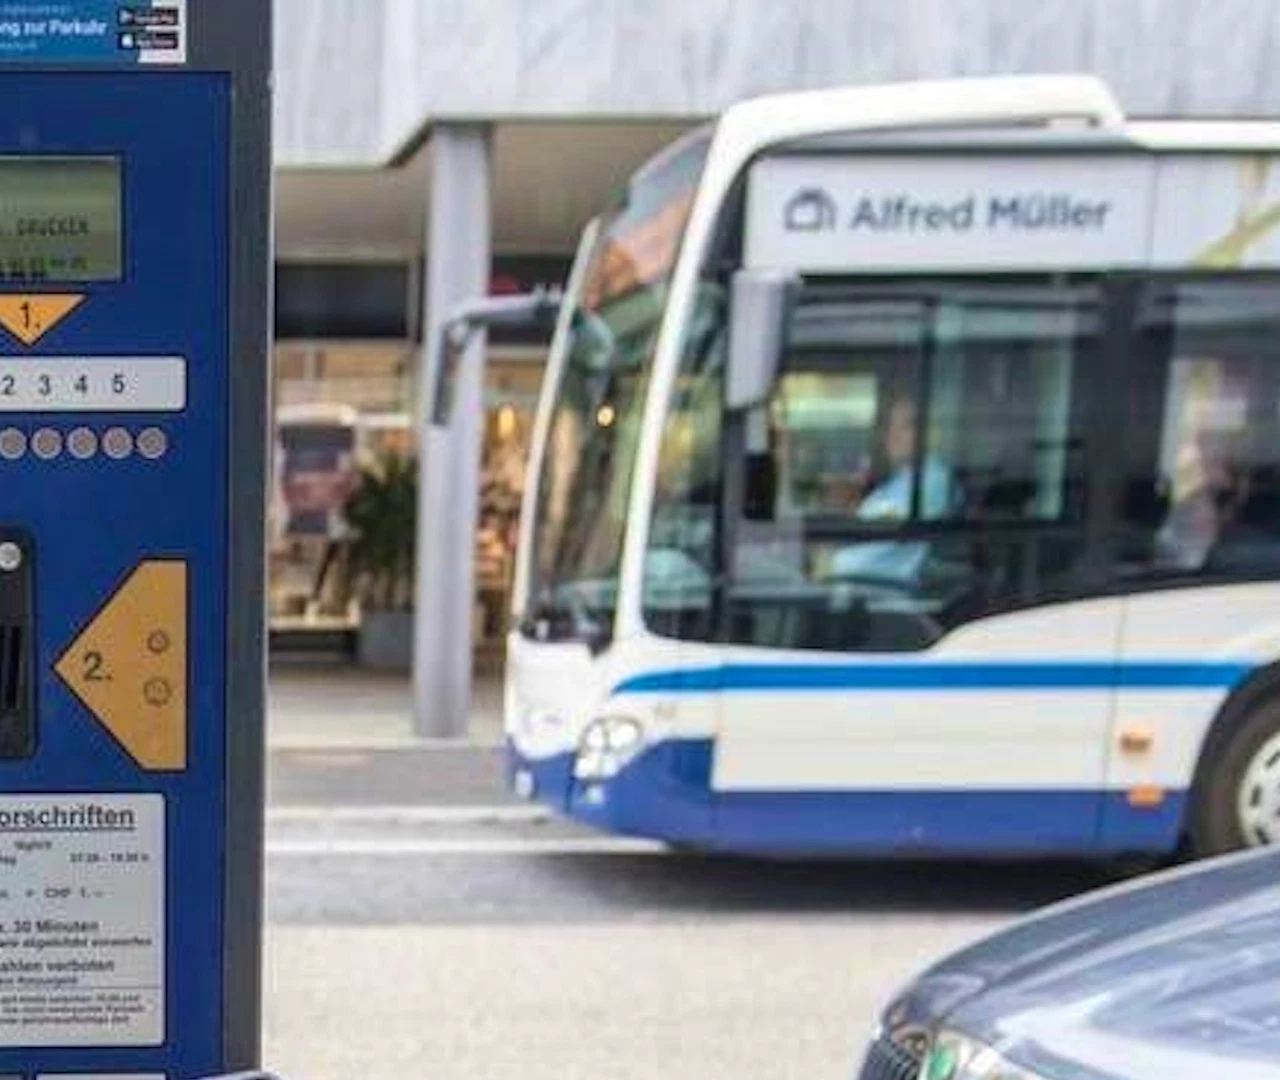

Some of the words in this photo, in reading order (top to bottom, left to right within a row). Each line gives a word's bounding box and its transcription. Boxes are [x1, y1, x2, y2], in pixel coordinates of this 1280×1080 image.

[23, 22, 46, 35] zur
[48, 18, 107, 35] Parkuhr
[848, 194, 974, 232] Alfred
[987, 193, 1112, 232] Müller
[19, 301, 41, 329] 1.
[1, 376, 15, 396] 2
[38, 376, 52, 396] 3
[74, 375, 89, 395] 4
[111, 374, 125, 394] 5
[83, 652, 113, 682] 2.
[35, 919, 99, 933] Minuten
[46, 959, 115, 972] verboten
